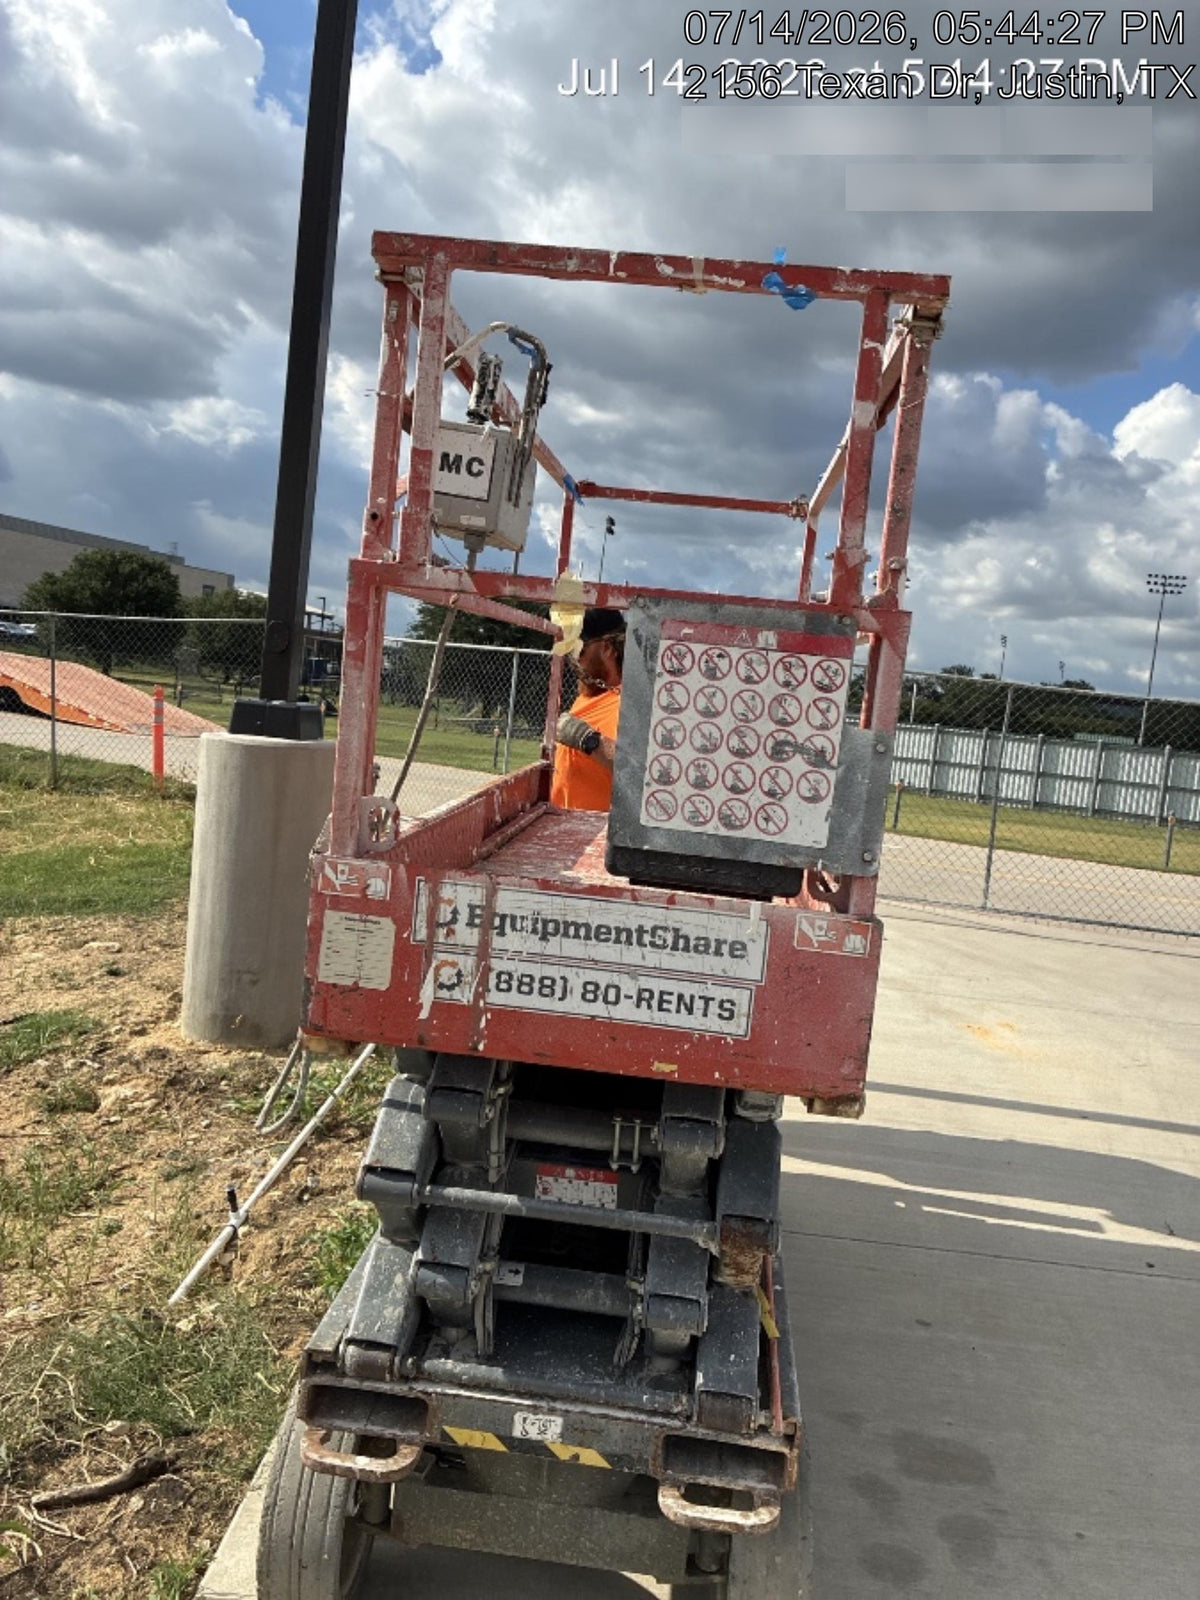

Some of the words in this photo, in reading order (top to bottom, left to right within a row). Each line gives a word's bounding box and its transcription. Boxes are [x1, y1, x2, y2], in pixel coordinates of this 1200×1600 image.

[438, 451, 485, 478] MC
[465, 902, 748, 960] EquipmentShare
[484, 967, 569, 1002] 888)
[580, 980, 737, 1022] 80-RENTS
